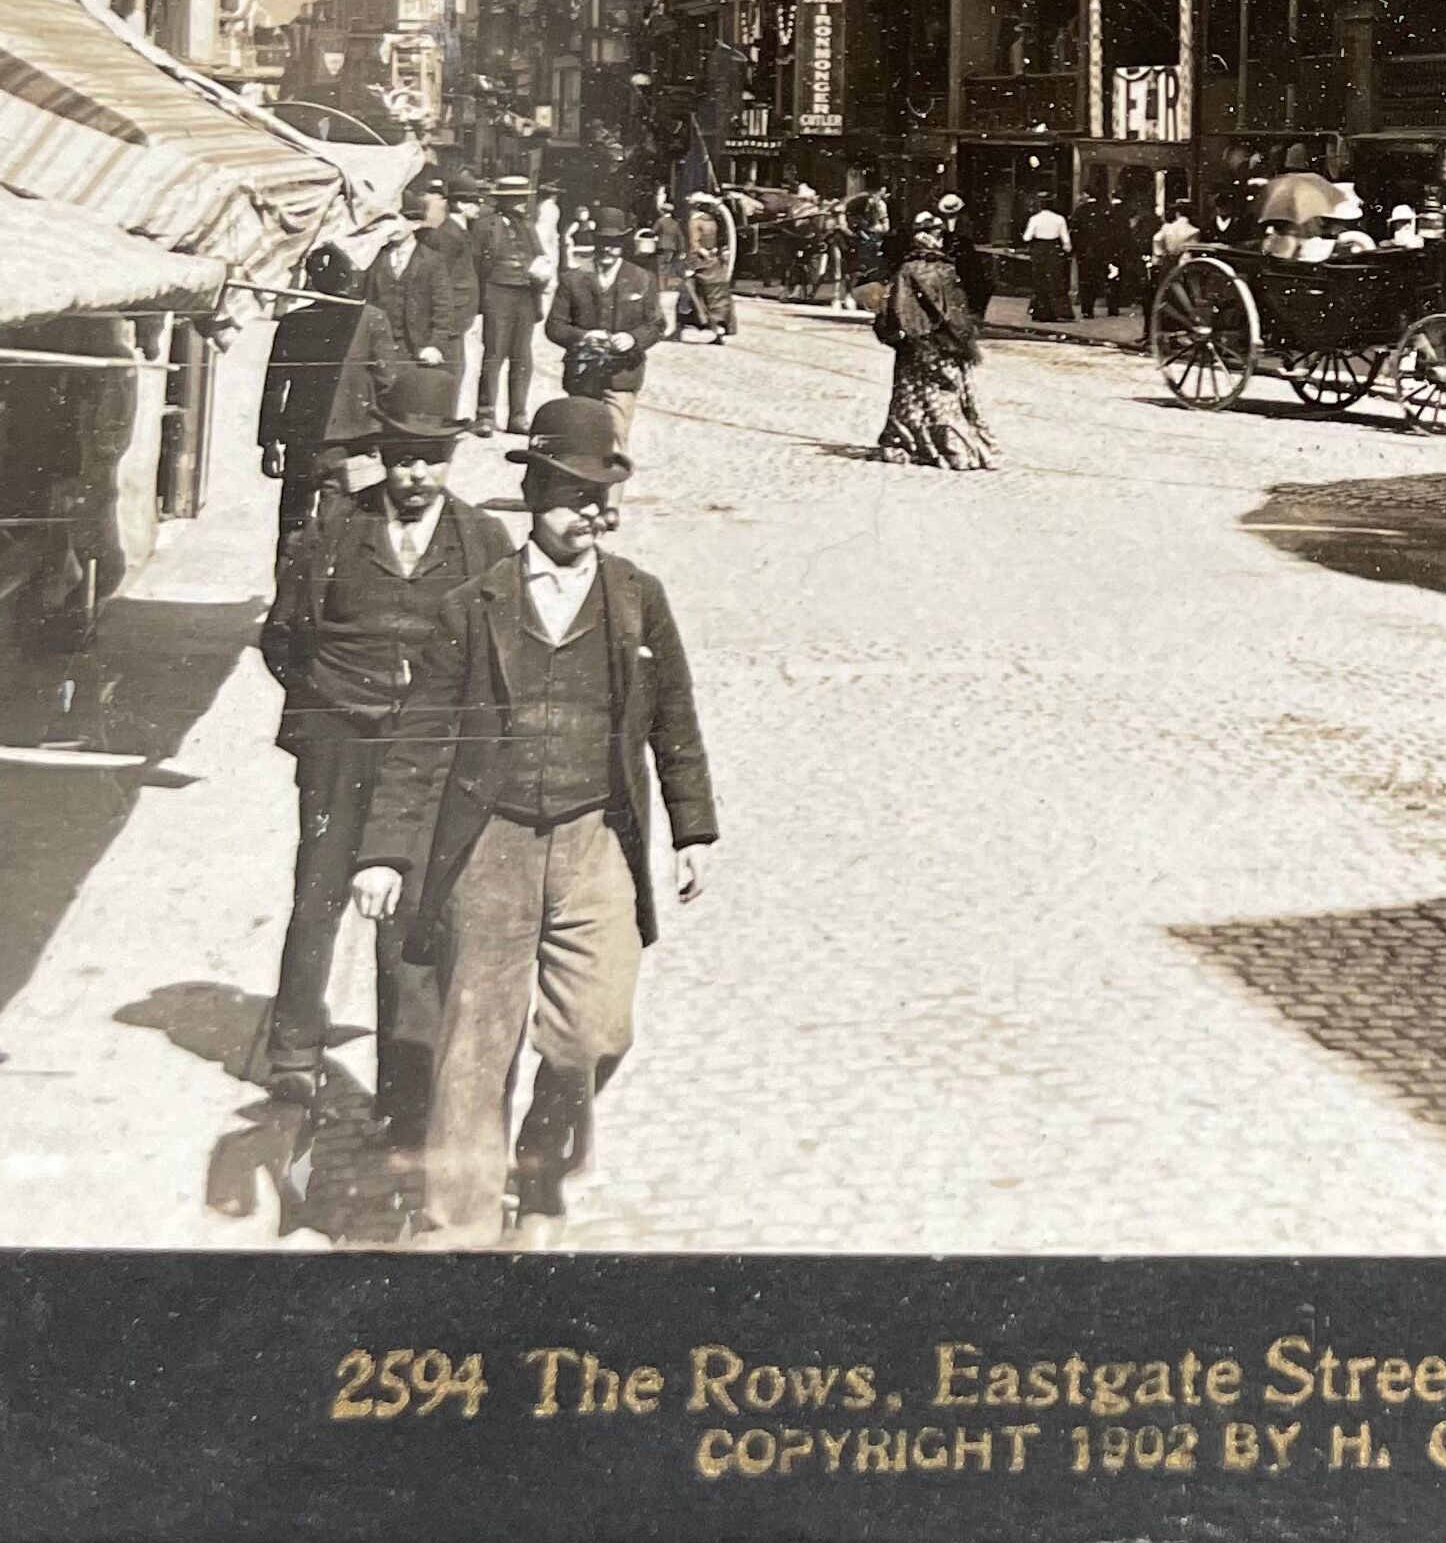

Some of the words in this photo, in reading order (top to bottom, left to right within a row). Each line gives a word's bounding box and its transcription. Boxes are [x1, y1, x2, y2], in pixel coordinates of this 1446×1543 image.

[813, 3, 832, 114] IRONMONGER
[331, 1347, 488, 1419] 2594
[525, 1346, 664, 1417] The
[933, 1341, 1243, 1417] Eastgate
[696, 1423, 1040, 1478] COPYRIGHT
[1071, 1423, 1199, 1472] 1902
[1222, 1421, 1301, 1471] BY
[1329, 1420, 1392, 1469] H.
